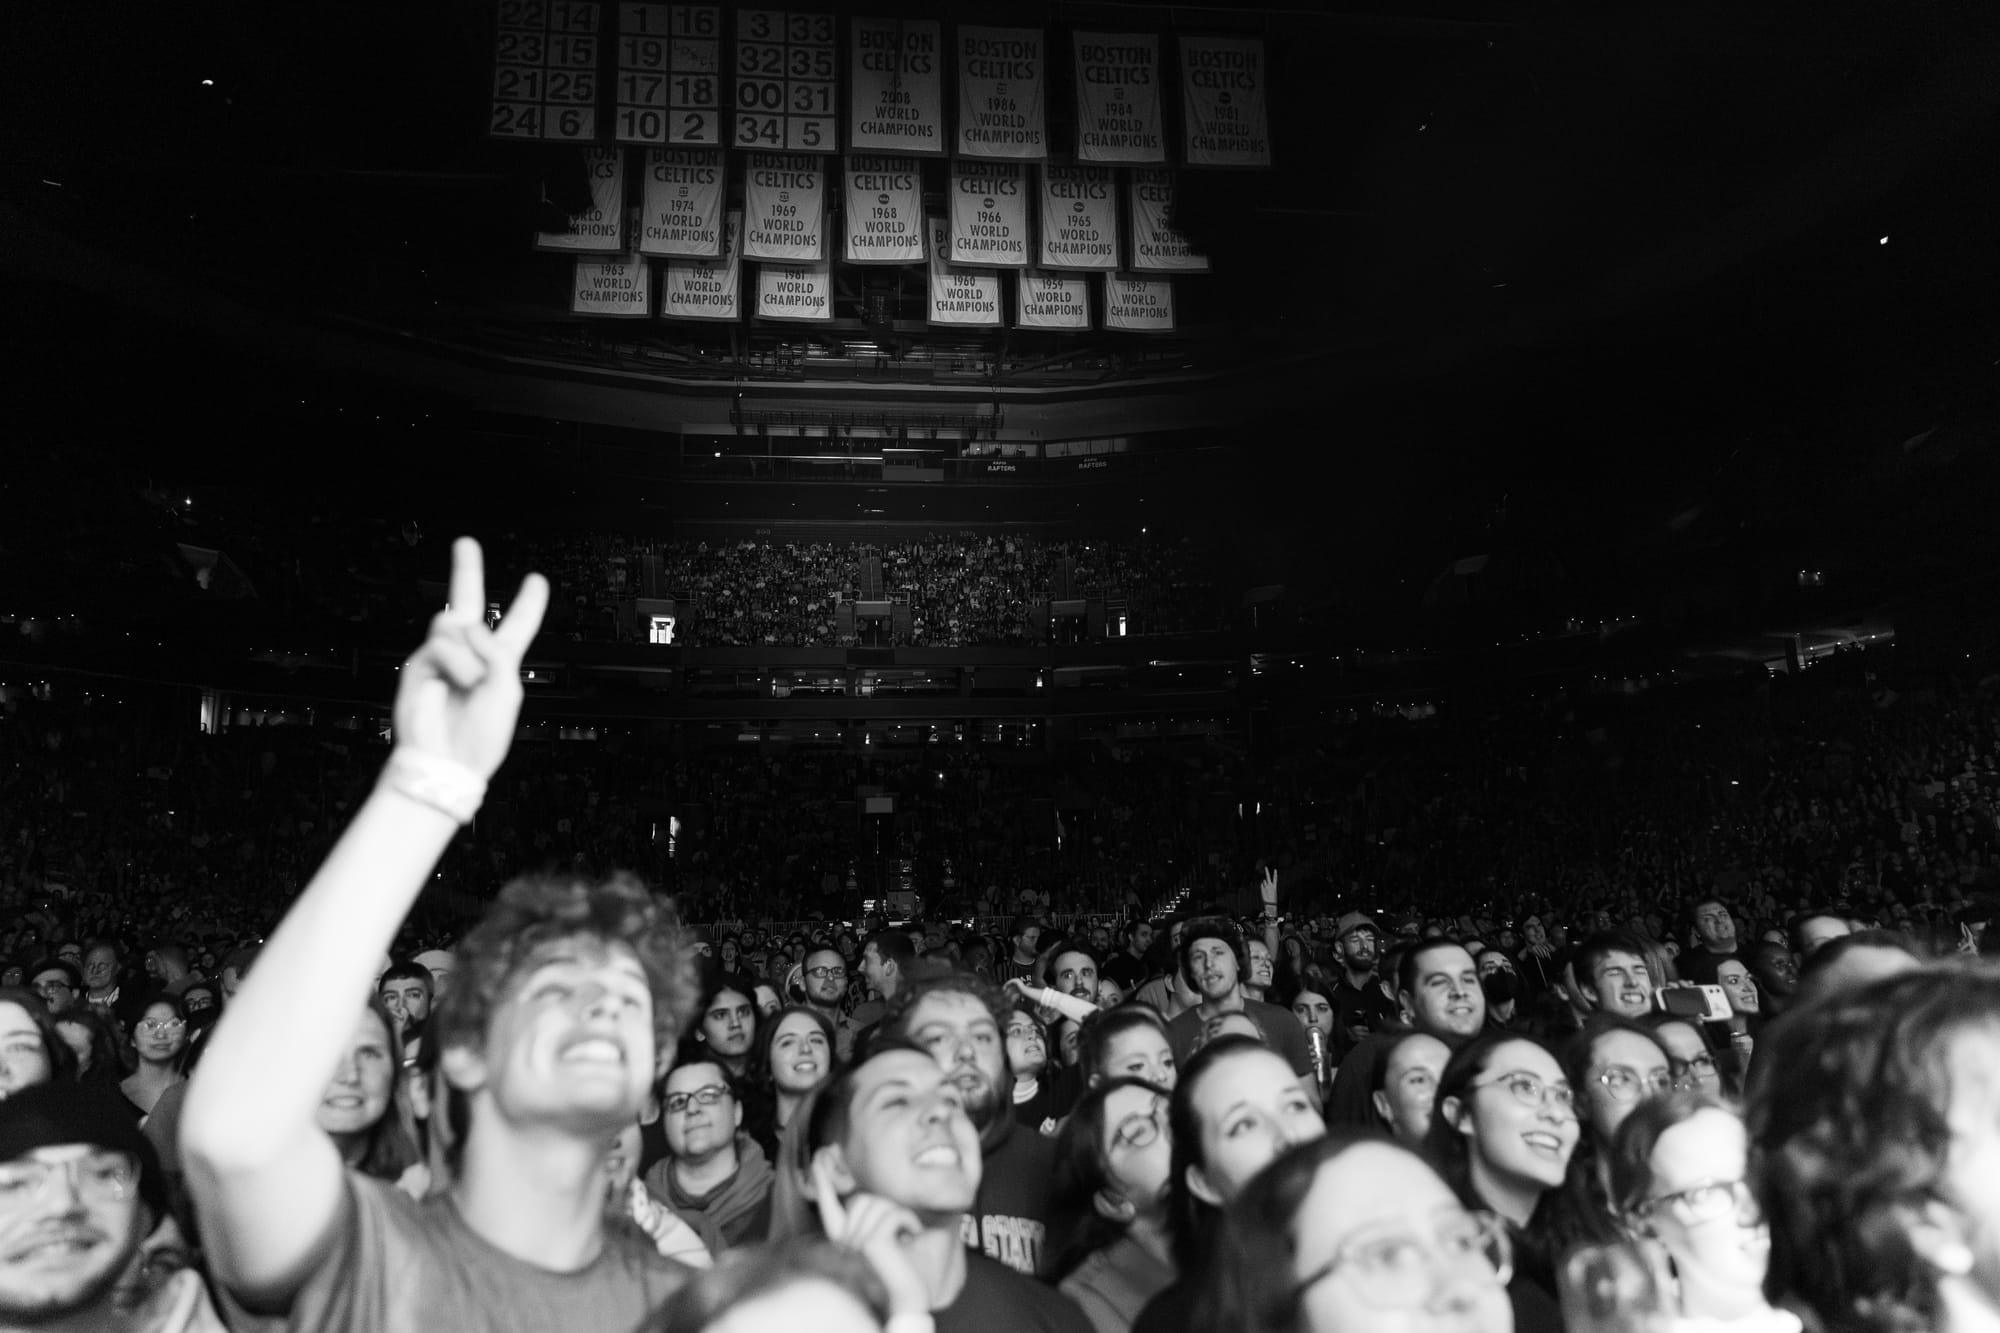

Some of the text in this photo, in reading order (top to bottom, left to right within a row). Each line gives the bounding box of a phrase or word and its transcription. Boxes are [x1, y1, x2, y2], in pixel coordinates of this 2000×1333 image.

[556, 5, 593, 31] 14
[632, 7, 714, 34] 1 16
[752, 13, 832, 42] 3 33
[500, 33, 593, 64] 23 15
[860, 30, 934, 53] BOSON
[965, 38, 1037, 60] BOSTON
[624, 40, 662, 67] 19
[740, 46, 832, 76] 32 35
[1080, 44, 1152, 65] BOSTON
[1188, 49, 1257, 70] BOSTON
[863, 53, 931, 74] CELICS
[968, 59, 1034, 80] CELTICS
[1085, 65, 1150, 85] CELTICS
[1191, 70, 1256, 91] CELTICS
[499, 70, 593, 101] 21 25
[624, 76, 713, 105] 17 18
[739, 81, 829, 111] 00 31
[989, 97, 1016, 111] 1986
[492, 105, 580, 137] 24 6
[876, 106, 919, 121] WORLD
[980, 112, 1025, 128] WORLD
[621, 110, 705, 140] 10 2
[739, 116, 821, 147] 34 5
[860, 122, 934, 137] CHAMPIONS
[1098, 118, 1143, 132] WORLD
[1206, 121, 1249, 136] WORLD
[965, 128, 1040, 145] CHAMPIONS
[1084, 132, 1157, 149] CHAMPIONS
[1191, 135, 1265, 152] CHAMPIONS
[752, 153, 817, 171] BOSTON
[654, 165, 715, 184] CELTICS
[755, 171, 815, 189] CELTICS
[854, 174, 913, 191] CELTICS
[960, 178, 1017, 196] CELTICS
[1050, 182, 1107, 200] CELTICS
[671, 200, 694, 213] 1974
[771, 204, 797, 217] 1969
[872, 207, 898, 219] 1968
[661, 213, 703, 228] WORLD
[763, 218, 804, 232] WORLD
[977, 211, 1002, 223] 1966
[1067, 215, 1091, 227] 1965
[646, 226, 715, 243] CHAMPIONS
[865, 221, 906, 233] WORLD
[970, 225, 1010, 238] WORLD
[750, 230, 817, 247] CHAMPIONS
[852, 234, 919, 248] CHAMPIONS
[1060, 229, 1100, 242] WORLD
[957, 237, 1022, 253] CHAMPIONS
[1047, 242, 1112, 256] CHAMPIONS
[601, 265, 625, 276] 1963
[593, 277, 632, 290] WORLD
[684, 279, 722, 293] WORLD
[777, 281, 814, 294] WORLD
[953, 275, 976, 287] 1960
[579, 289, 643, 304] CHAMPIONS
[671, 292, 733, 307] CHAMPIONS
[764, 293, 825, 307] CHAMPIONS
[946, 288, 983, 300] WORLD
[1036, 291, 1072, 303] WORLD
[1121, 294, 1157, 306] WORLD
[936, 300, 994, 313] CHAMPIONS
[1024, 304, 1084, 316] CHAMPIONS
[1110, 306, 1168, 319] CHAMPIONS
[987, 464, 1016, 473] RAFTERS
